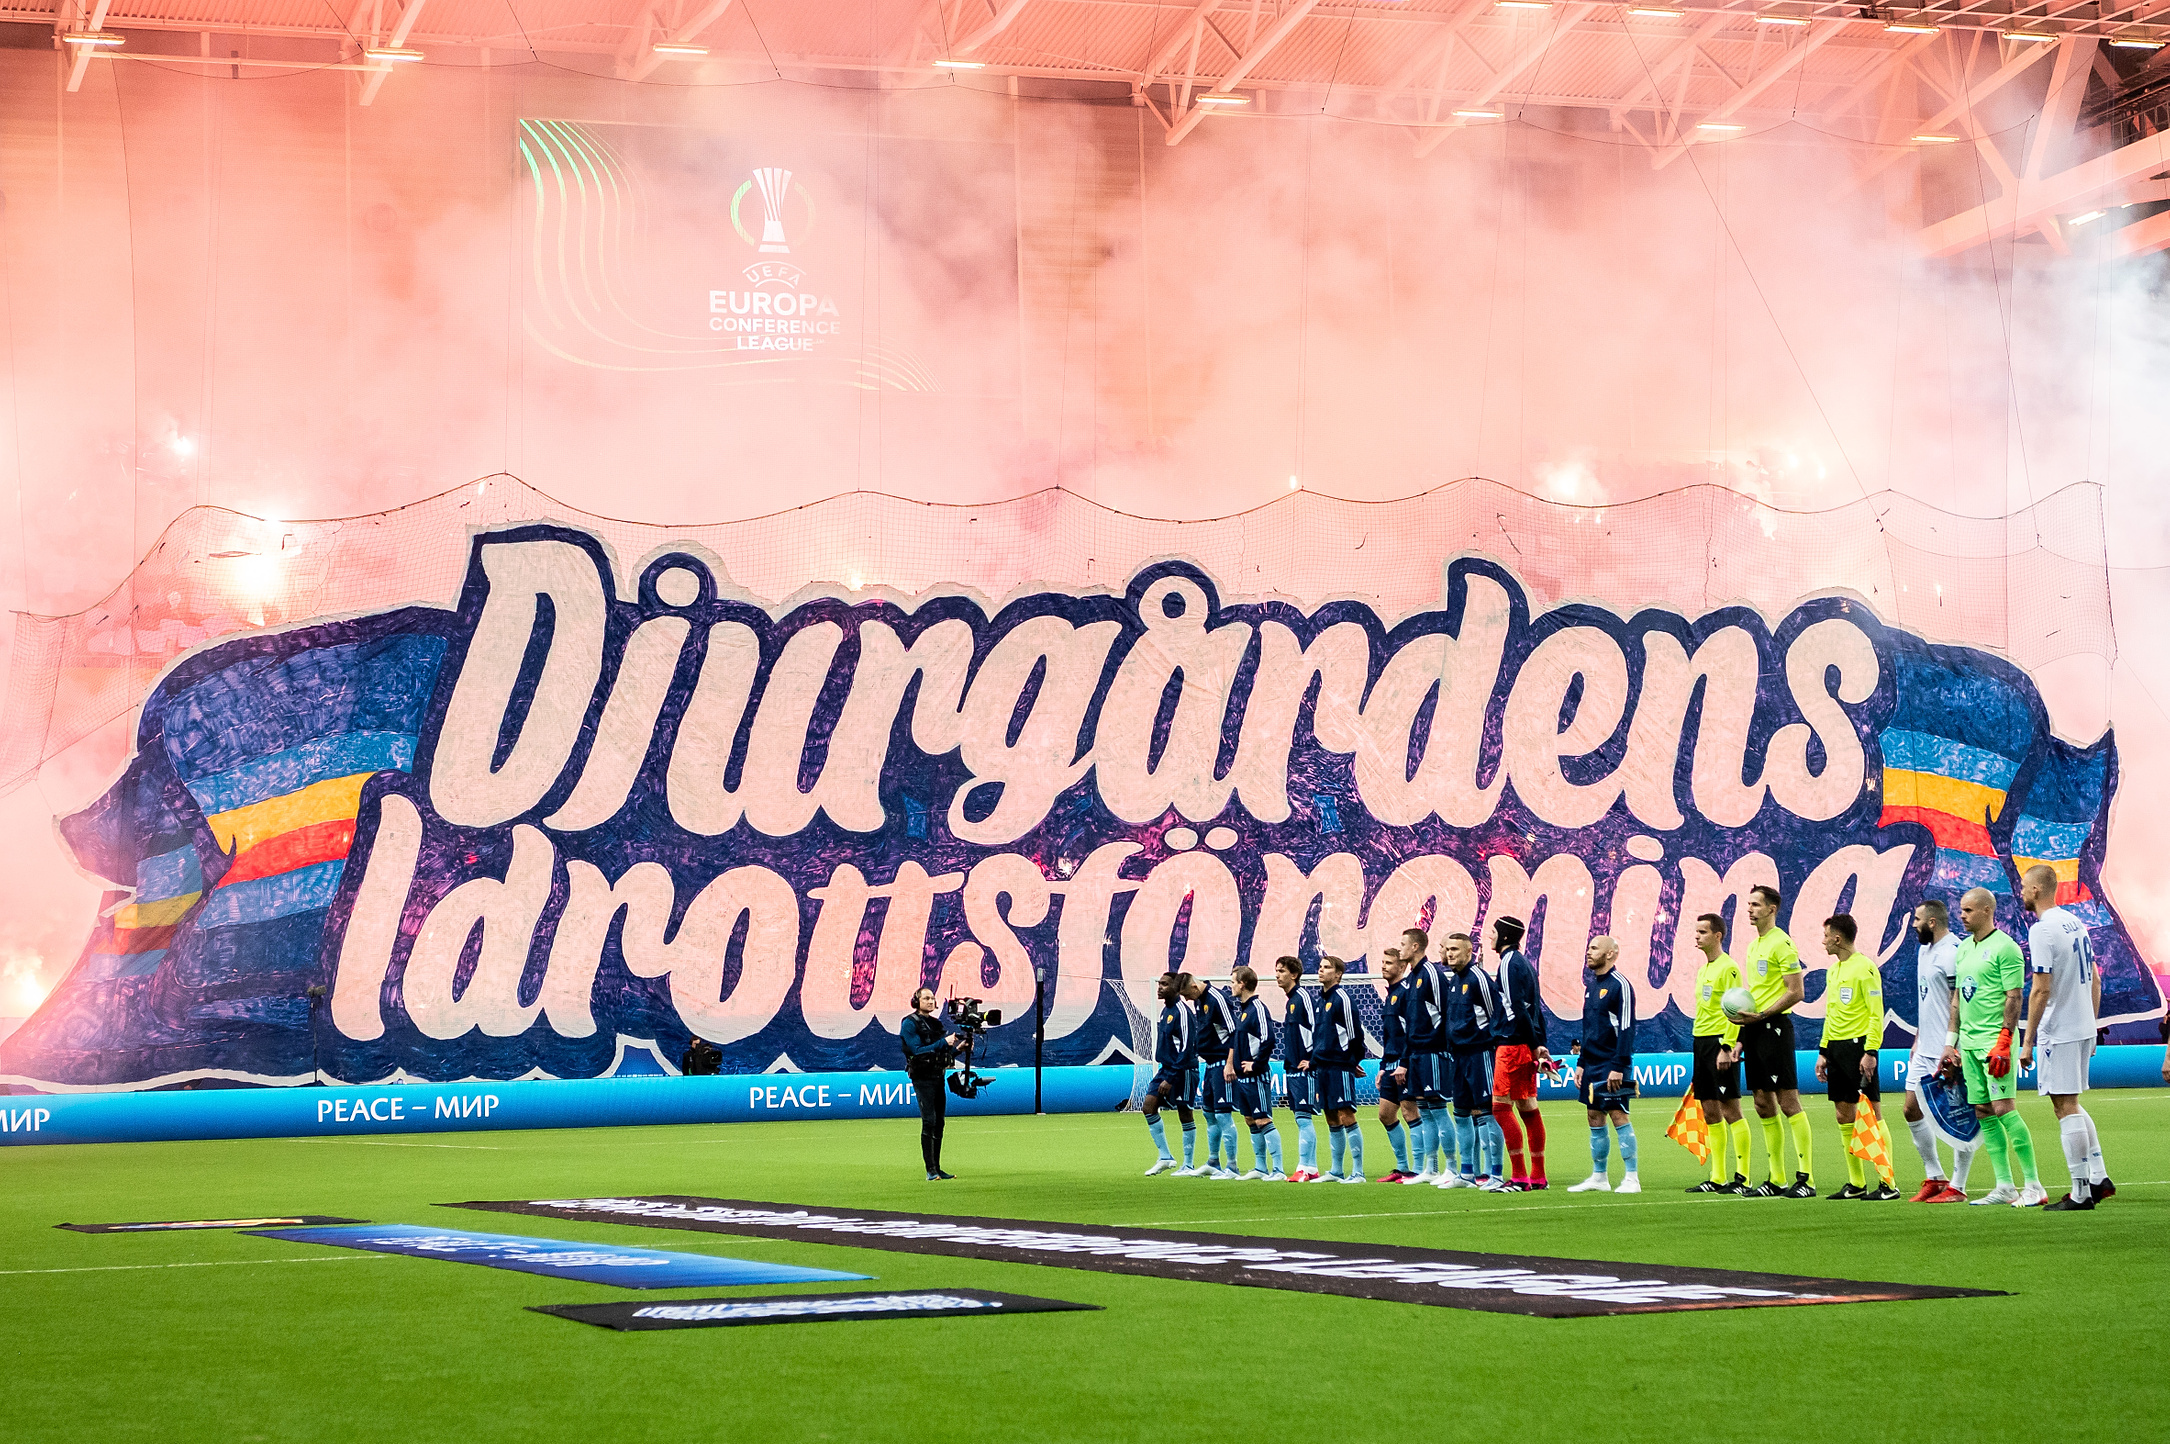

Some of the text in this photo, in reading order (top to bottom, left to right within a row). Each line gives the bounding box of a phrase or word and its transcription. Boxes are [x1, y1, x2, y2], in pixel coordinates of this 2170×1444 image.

[746, 265, 801, 286] UEFA
[709, 290, 840, 317] EUROPA
[709, 317, 841, 335] CONFERENCE
[737, 336, 814, 352] LEAGUE
[428, 540, 1880, 845] Djurgårdens
[1633, 1064, 1687, 1086] МИР
[750, 1085, 831, 1109] PEACE
[318, 1097, 405, 1123] PEACE
[434, 1095, 500, 1119] МИР
